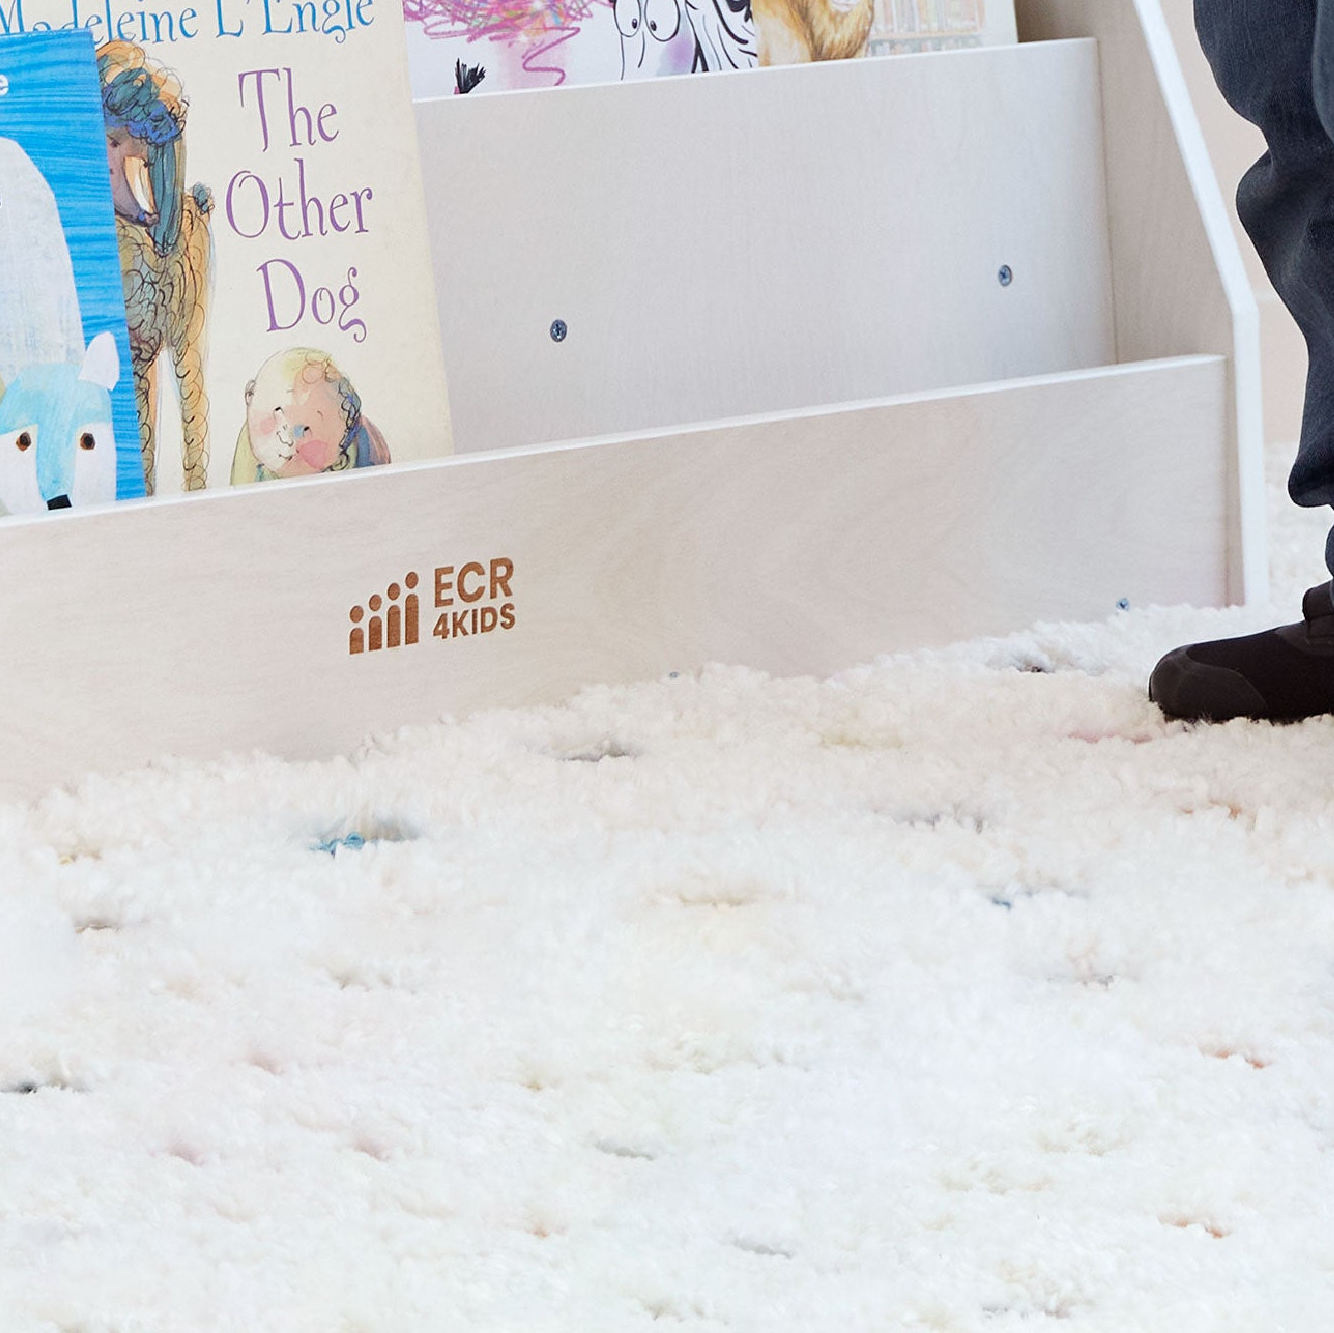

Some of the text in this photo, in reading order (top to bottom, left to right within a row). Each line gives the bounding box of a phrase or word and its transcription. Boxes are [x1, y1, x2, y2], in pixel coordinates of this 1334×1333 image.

[236, 66, 340, 152] The
[224, 157, 374, 241] Other
[255, 257, 368, 344] Dog
[431, 602, 517, 640] 4KIDS
[433, 556, 515, 609] ECR
